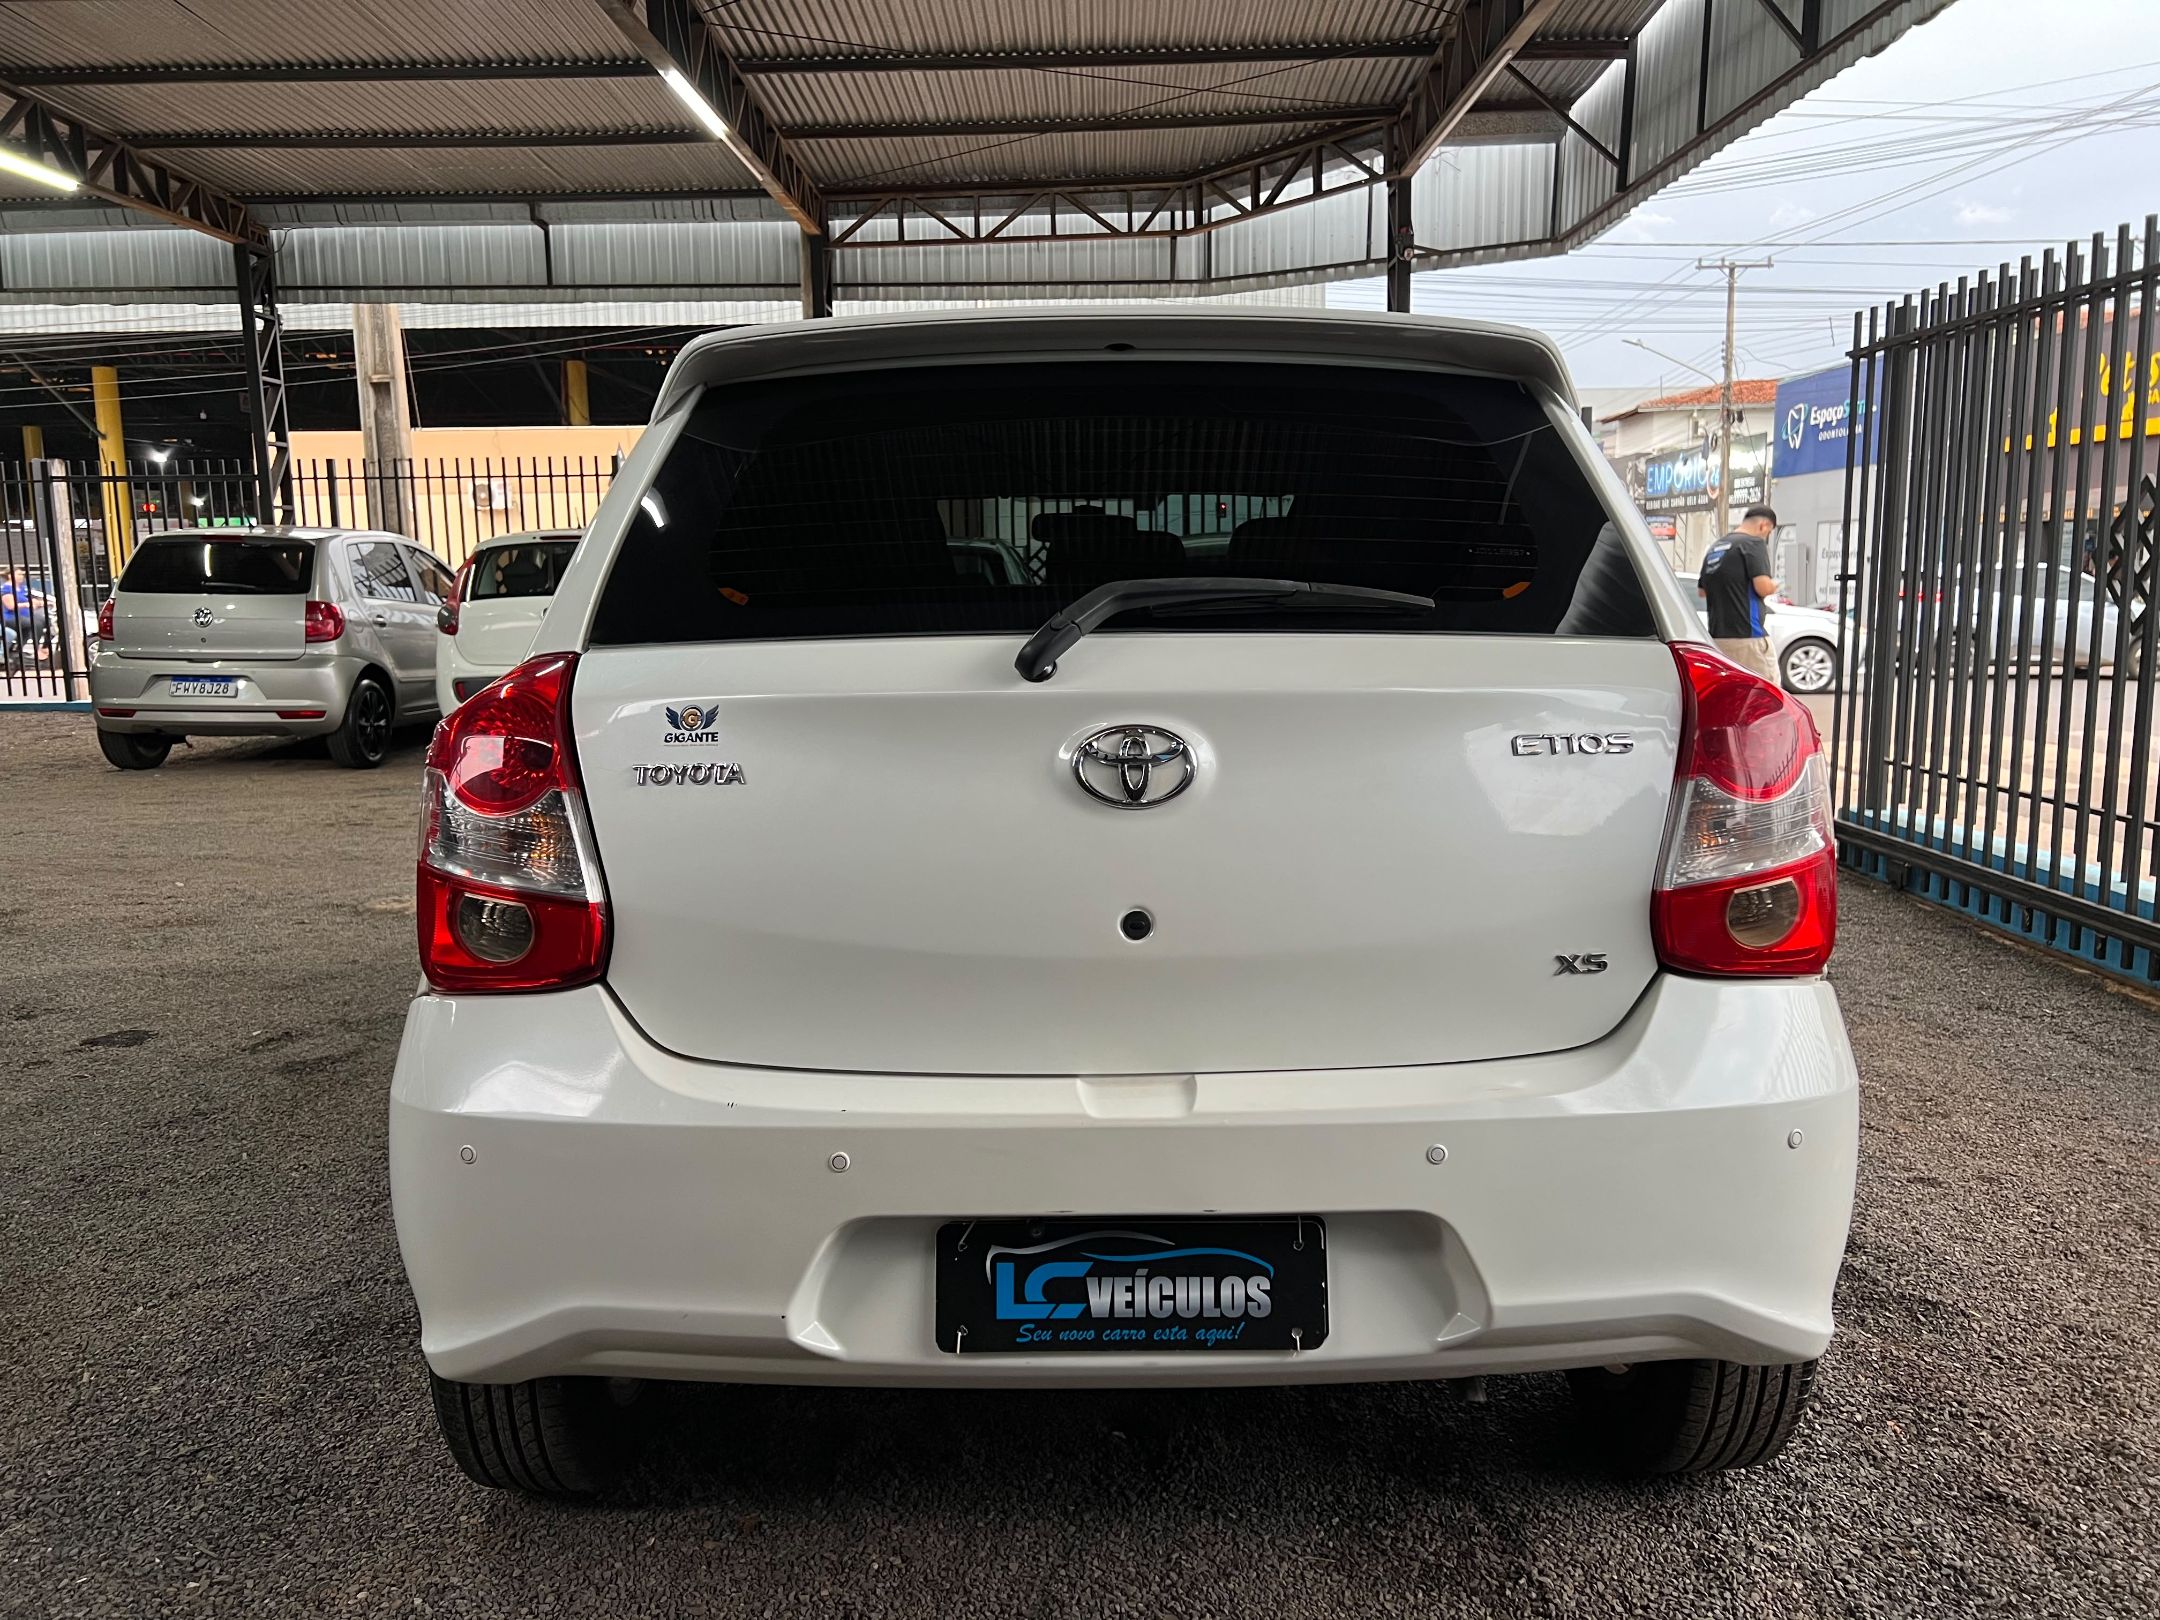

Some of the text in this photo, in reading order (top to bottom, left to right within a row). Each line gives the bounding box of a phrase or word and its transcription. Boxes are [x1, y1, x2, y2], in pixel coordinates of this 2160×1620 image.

[1647, 451, 1707, 493] EMPÓRIO
[175, 682, 229, 694] FWY8J28
[664, 731, 719, 743] GIGANTE
[1511, 733, 1634, 757] ETIOS
[632, 762, 746, 786] TOYOTA
[1554, 953, 1609, 976] XS
[996, 1261, 1272, 1320] LC VEÍCULOS
[1016, 1320, 1246, 1347] Seu novo carro esta aqui!
